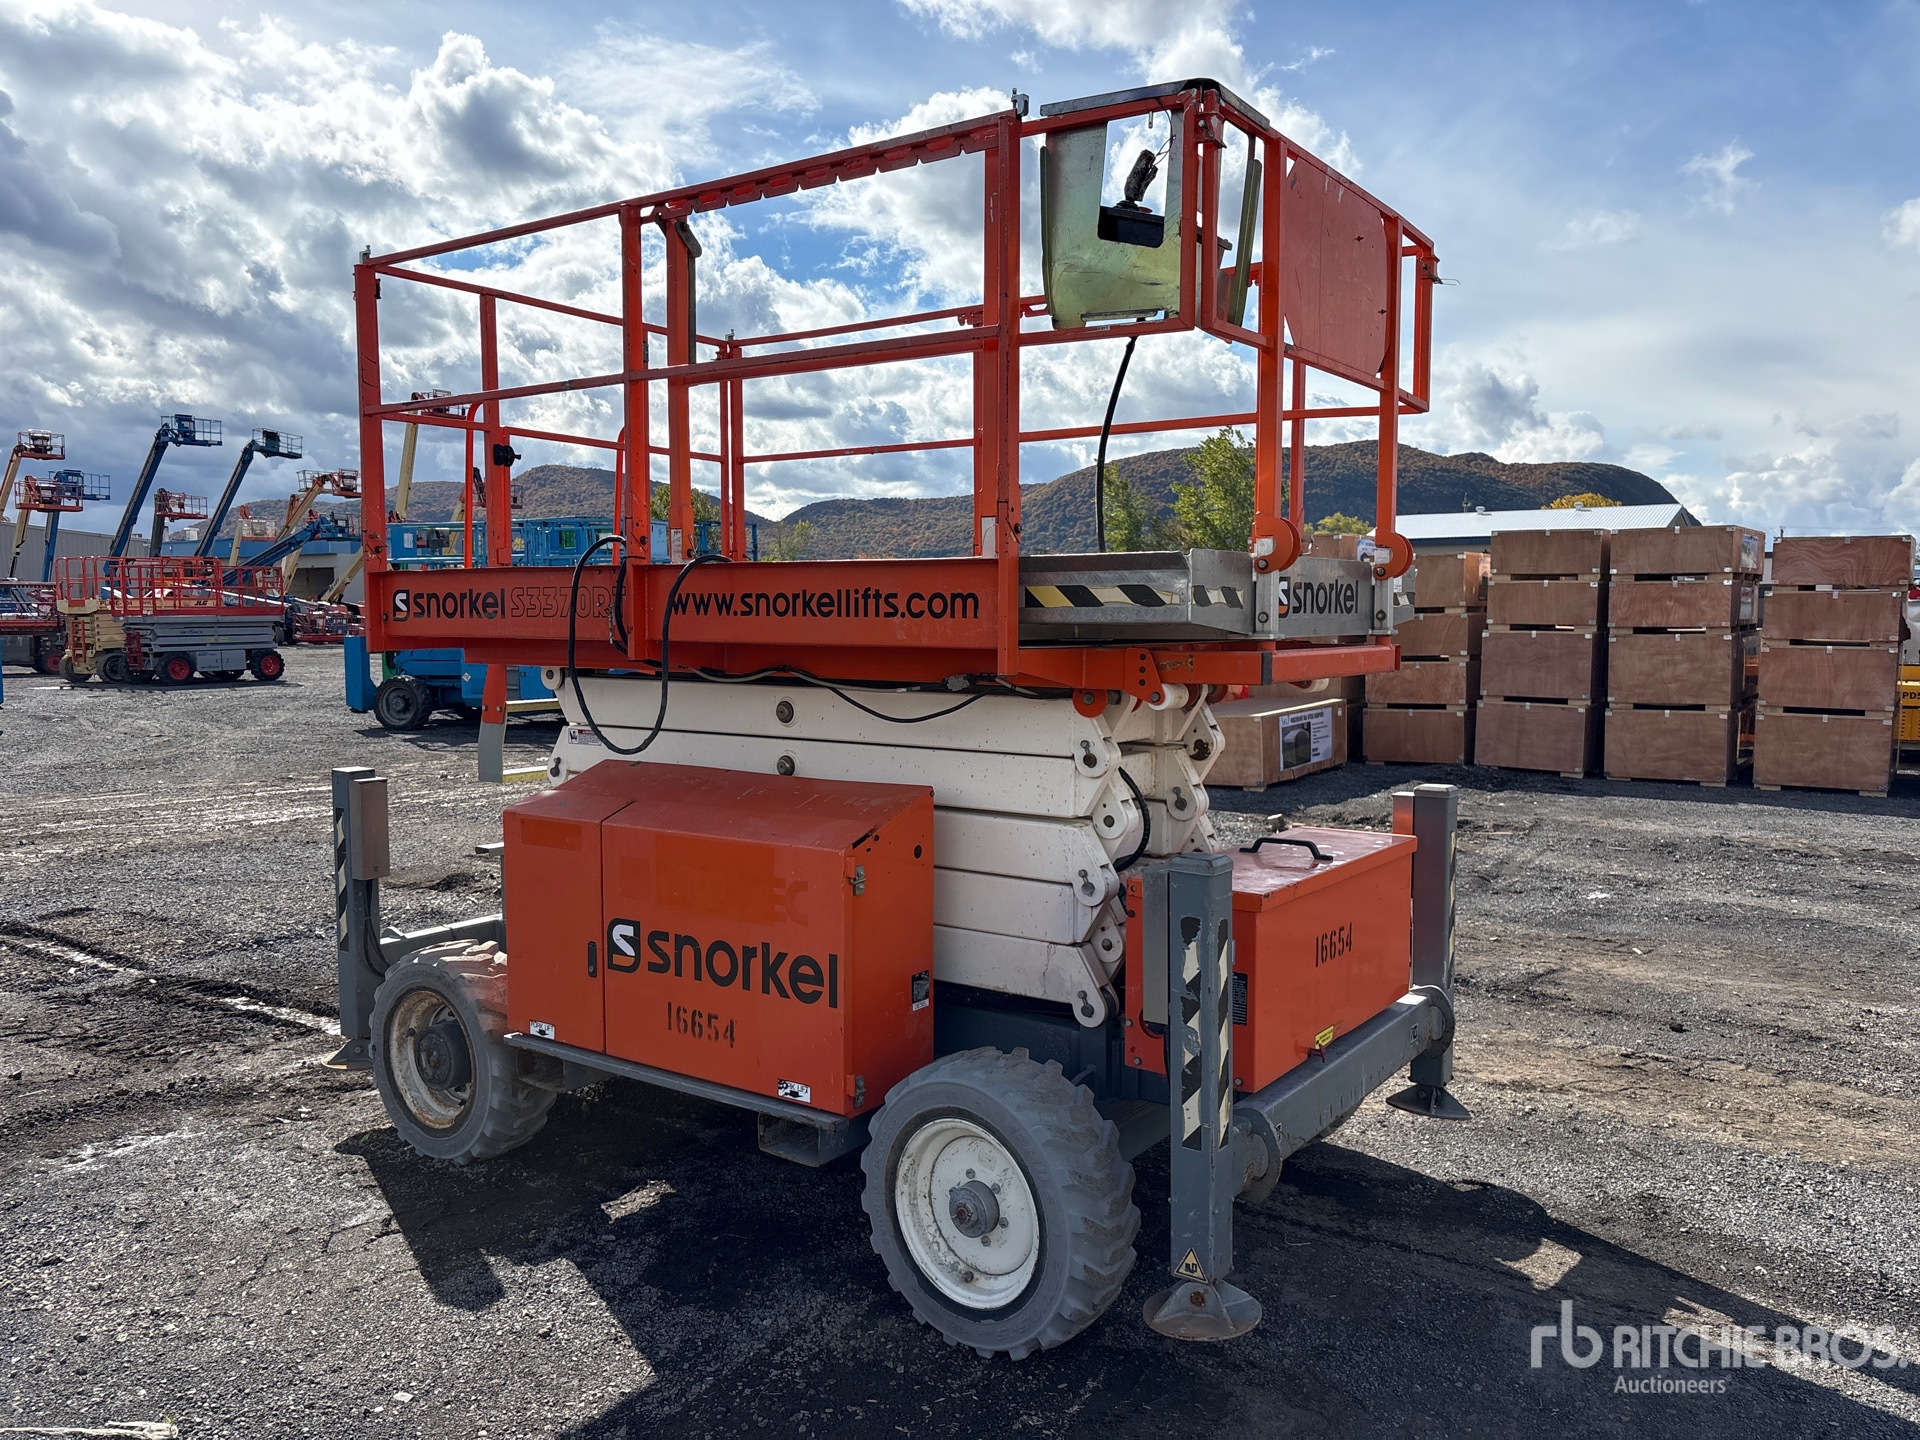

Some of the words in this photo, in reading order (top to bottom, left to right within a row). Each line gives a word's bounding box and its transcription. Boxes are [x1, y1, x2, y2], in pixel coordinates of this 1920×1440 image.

[413, 587, 506, 620] snorkel
[671, 586, 980, 620] www.snorkellifts.com
[1292, 578, 1359, 615] snorkel
[1315, 922, 1352, 967] 16654
[647, 929, 838, 1009] snorkel
[666, 1001, 737, 1049] 16654
